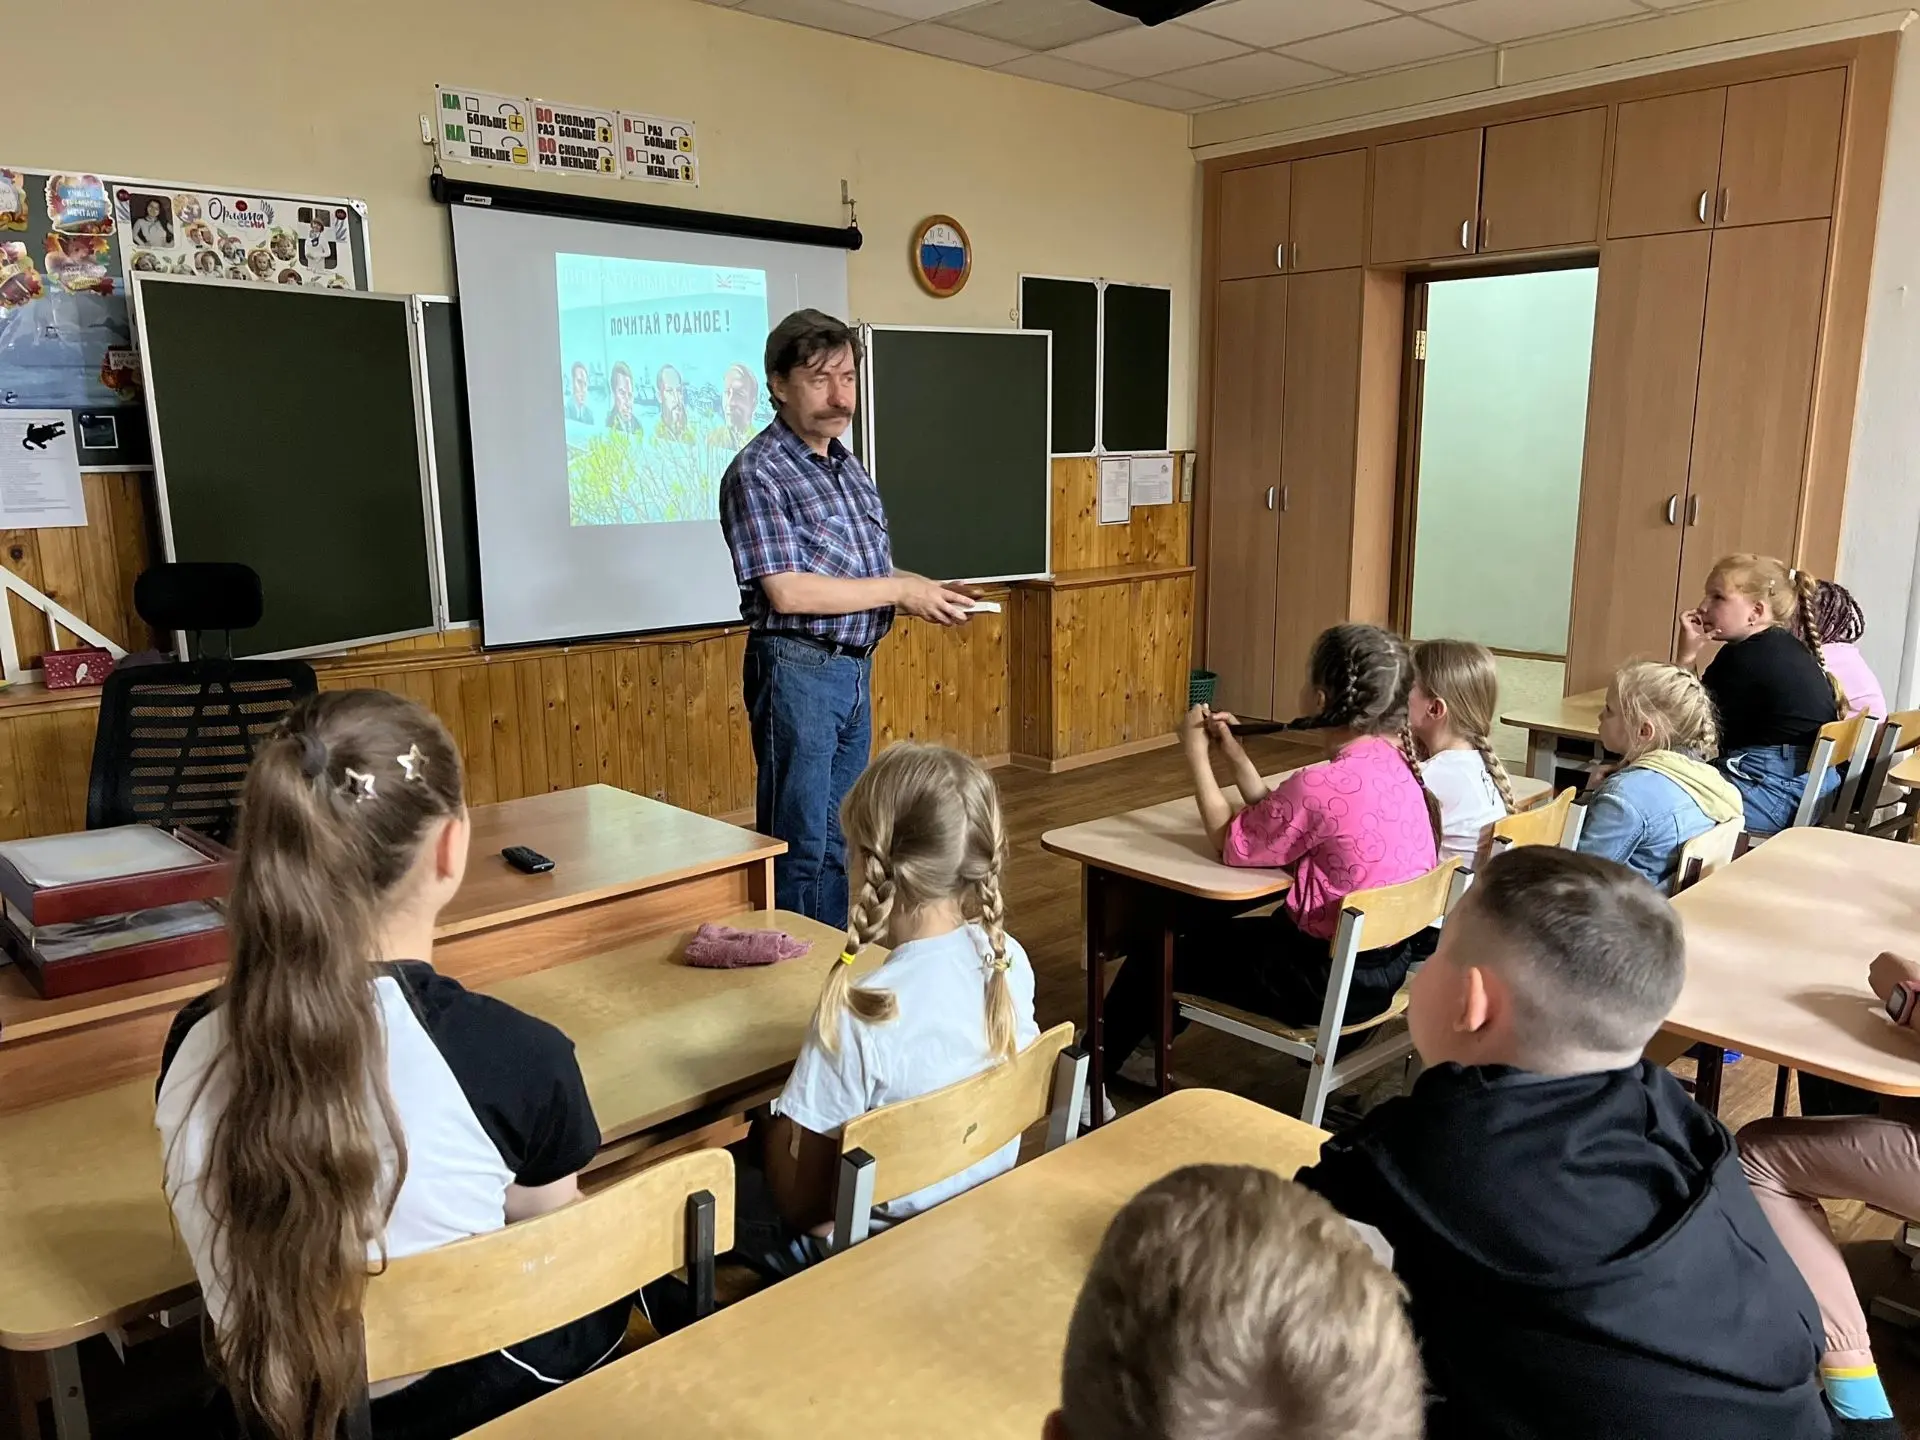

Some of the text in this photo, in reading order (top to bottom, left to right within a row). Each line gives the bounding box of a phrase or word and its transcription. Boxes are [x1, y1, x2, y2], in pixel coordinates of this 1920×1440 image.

[442, 93, 461, 110] НА
[467, 112, 507, 130] БОЛЬШЕ
[536, 107, 596, 129] ВО СКОЛЬКО
[445, 123, 466, 142] НА
[537, 123, 596, 141] РАЗ БОЛЬШЕ
[623, 119, 663, 137] В РАЗ
[538, 137, 599, 159] ВО СКОЛЬКО
[644, 136, 677, 151] БОЛЬШЕ
[470, 145, 511, 162] МЕНЬШЕ
[539, 154, 597, 170] РАЗ МЕНЬШЕ
[626, 146, 665, 166] В РАЗ
[646, 165, 680, 179] МЕНЬШЕ
[610, 312, 661, 336] ПОЧИТАЙ
